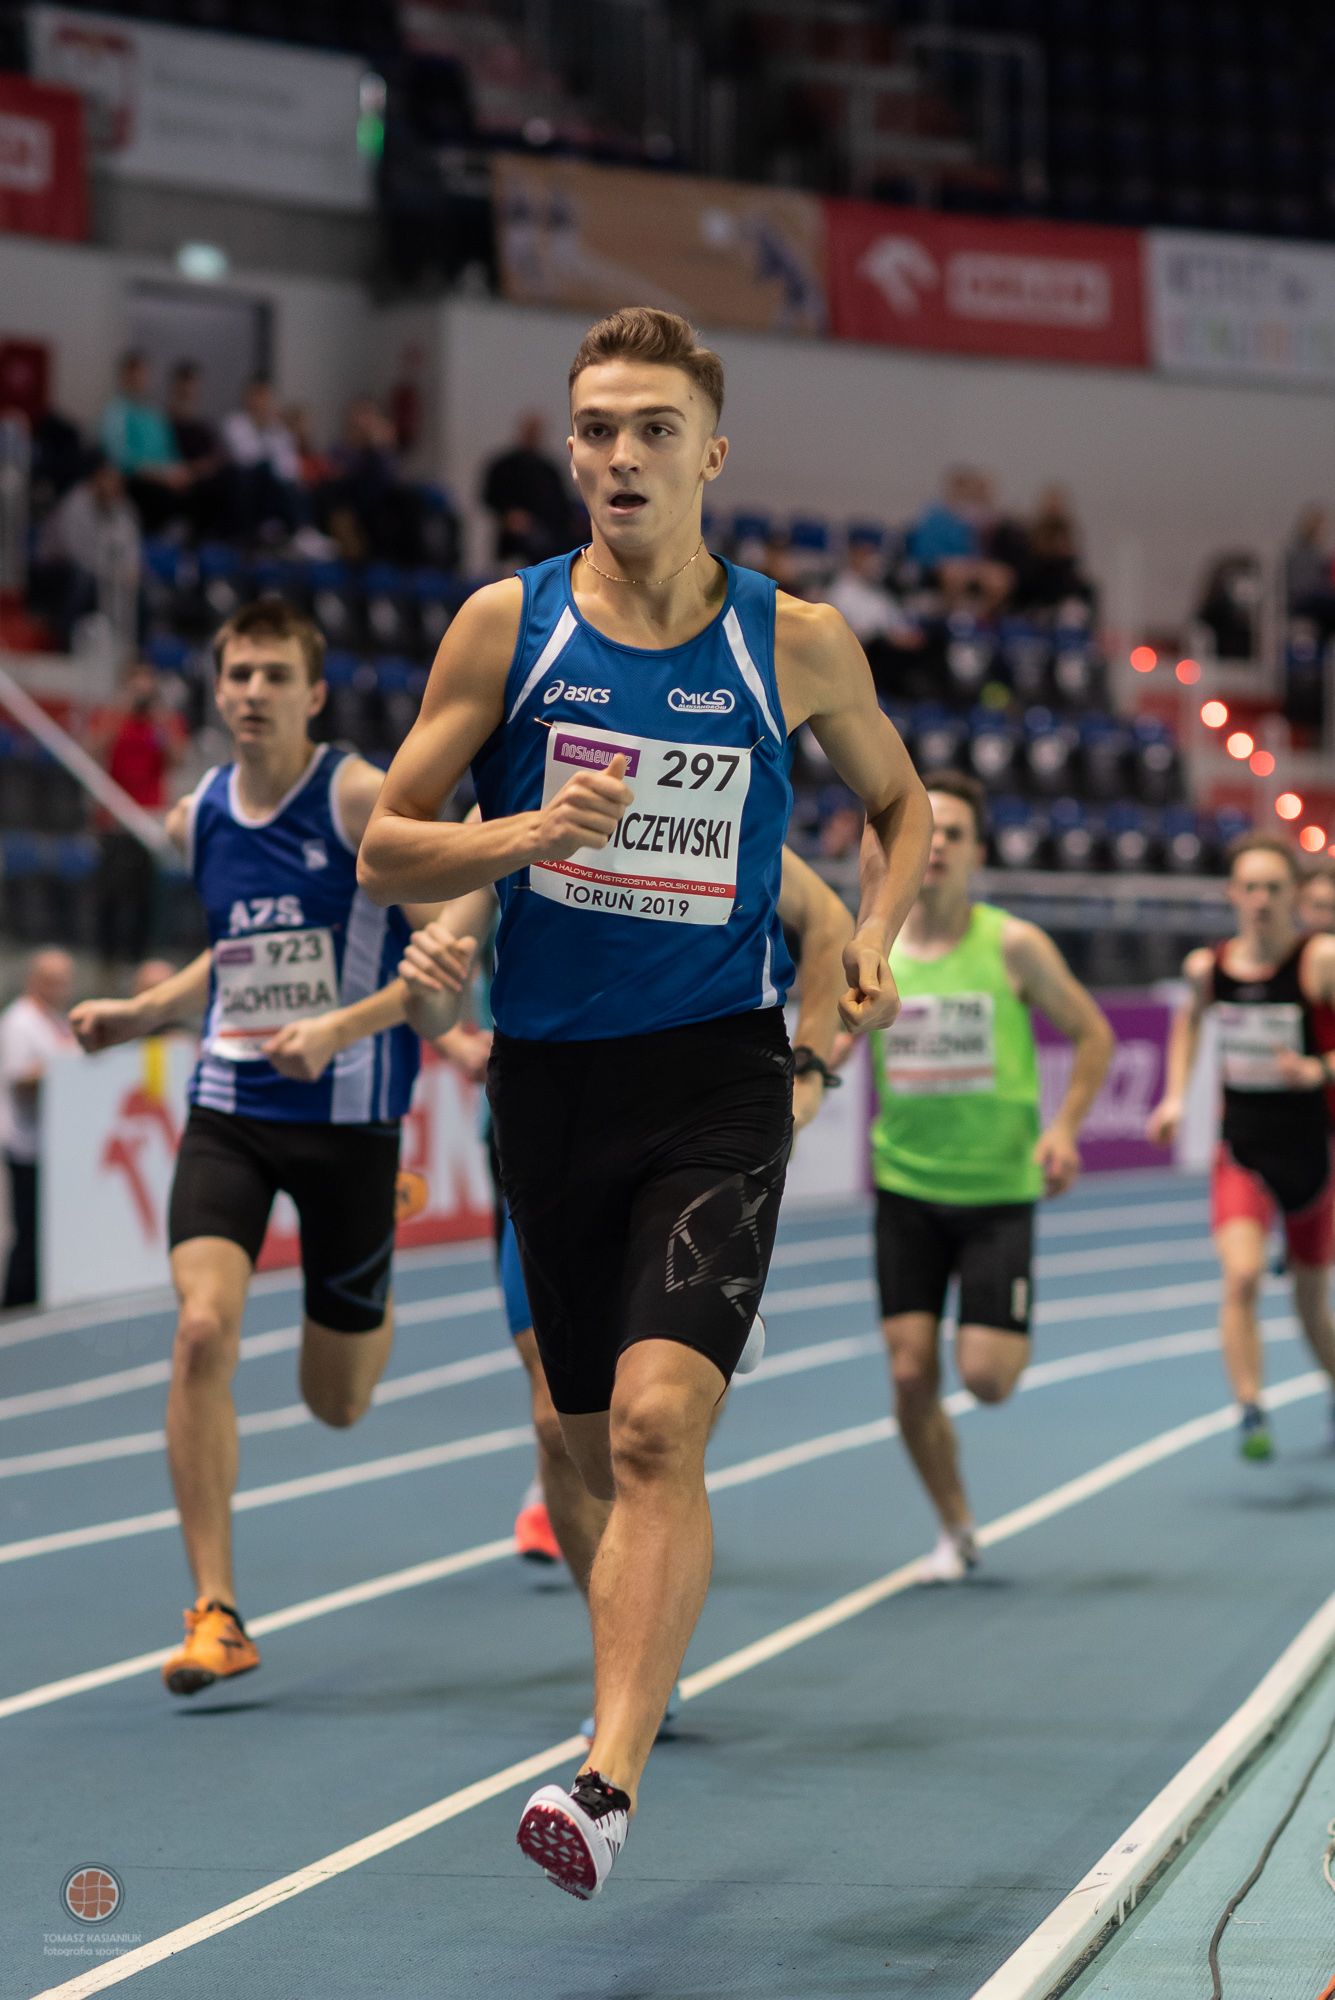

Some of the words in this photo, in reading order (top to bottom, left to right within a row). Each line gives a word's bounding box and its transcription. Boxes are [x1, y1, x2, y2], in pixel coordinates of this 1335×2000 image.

[564, 685, 611, 704] asics
[561, 743, 632, 770] noskiewz
[657, 750, 740, 792] 297
[608, 812, 731, 859] ICZEWSKI
[540, 859, 558, 868] ZLA
[559, 863, 593, 878] HALOWE
[595, 873, 657, 887] MISTRZOSTWA
[659, 881, 690, 890] POLSKI
[229, 895, 304, 935] AZS
[565, 882, 634, 911] TORUŃ
[640, 896, 689, 917] 2019
[267, 935, 322, 966] 923
